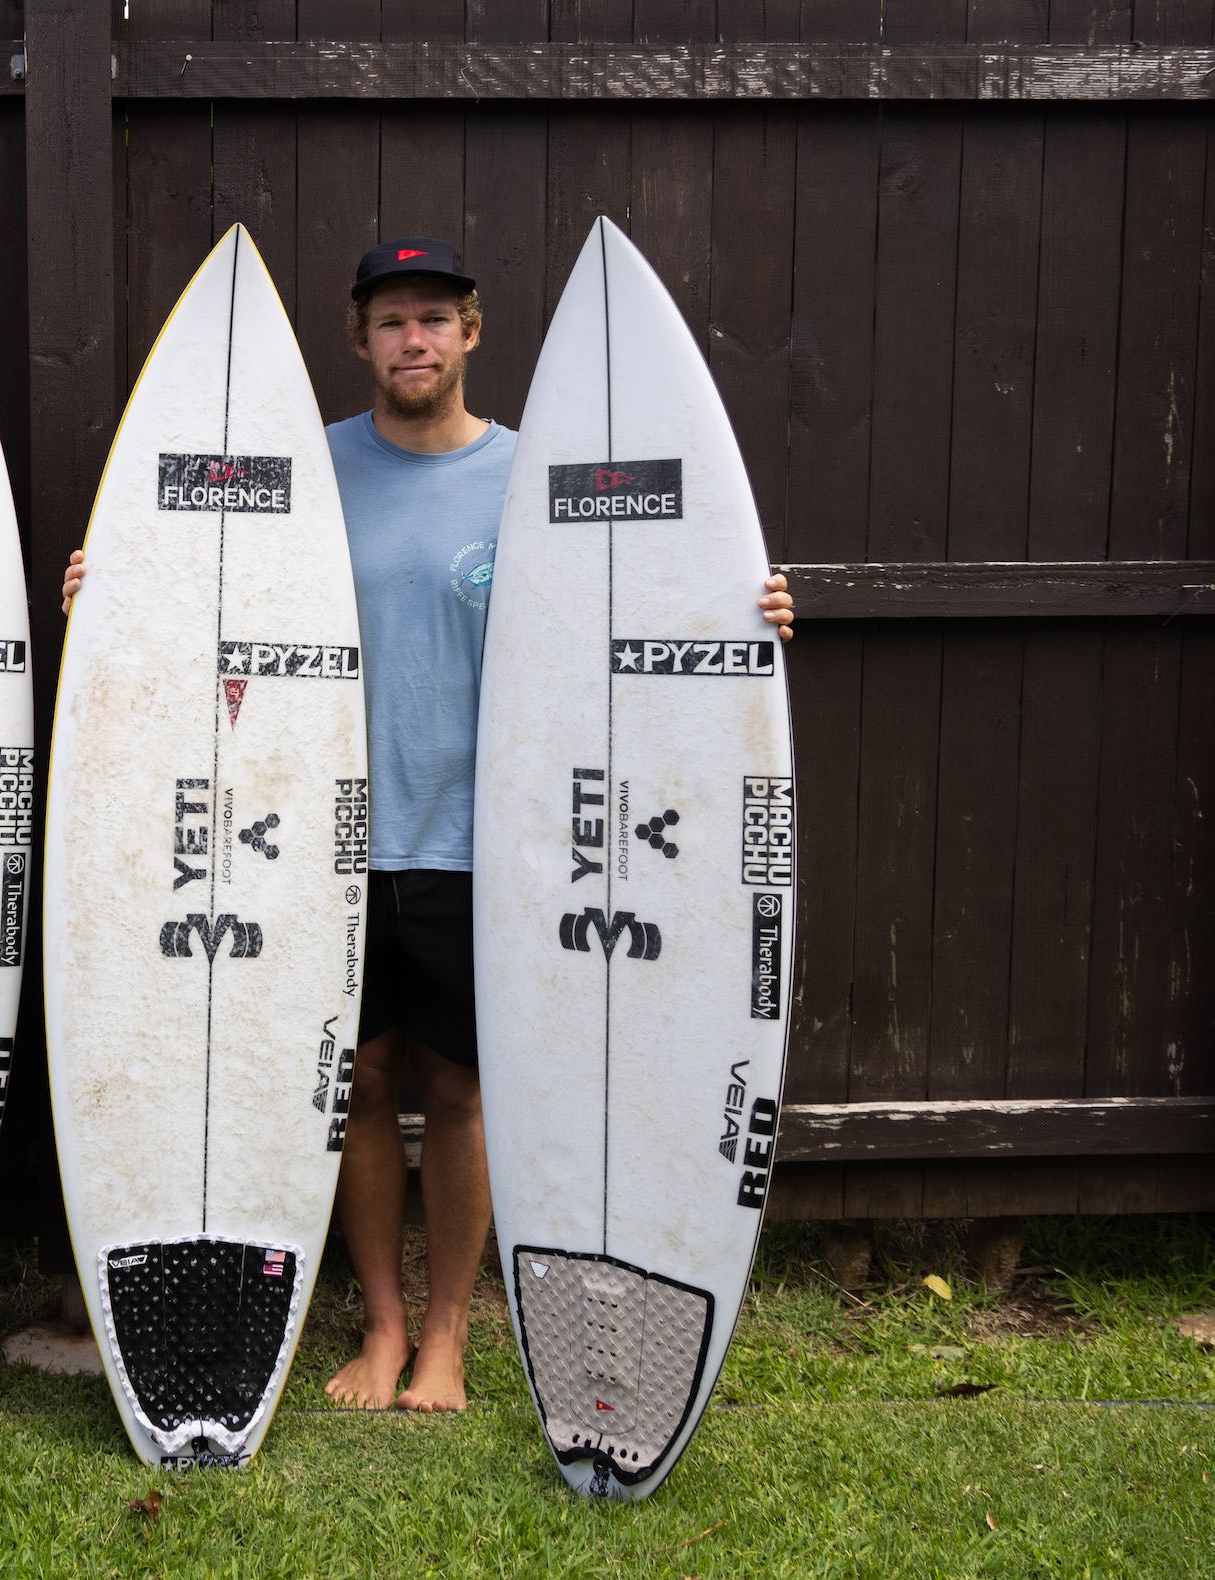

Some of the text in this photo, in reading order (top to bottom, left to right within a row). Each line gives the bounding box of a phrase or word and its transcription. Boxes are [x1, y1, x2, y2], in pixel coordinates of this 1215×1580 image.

[164, 486, 285, 508] FLORENCE
[554, 494, 676, 518] FLORENCE
[450, 541, 485, 572] FLORENCE
[450, 579, 487, 610] RIFFE SPE
[251, 644, 359, 679] PYZEL
[643, 642, 774, 675] PYZEL
[15, 748, 34, 845] MACHU
[173, 778, 210, 891] YETI
[222, 788, 234, 885] VIVOBAREFOOT
[334, 779, 353, 875] PICCHU
[352, 778, 367, 875] MACHU
[572, 768, 605, 884] YETI
[618, 780, 629, 882] VIVOBAREFOOT
[743, 778, 769, 884] PICCHU
[768, 779, 792, 885] MACHU
[1, 881, 22, 965] Therabody
[343, 912, 360, 997] Therabody
[753, 925, 778, 1018] Therabody
[313, 1016, 339, 1094] VEIA
[327, 1048, 355, 1152] RED
[720, 1059, 751, 1140] VEIA
[737, 1096, 777, 1209] RED
[111, 1258, 140, 1267] VEIA
